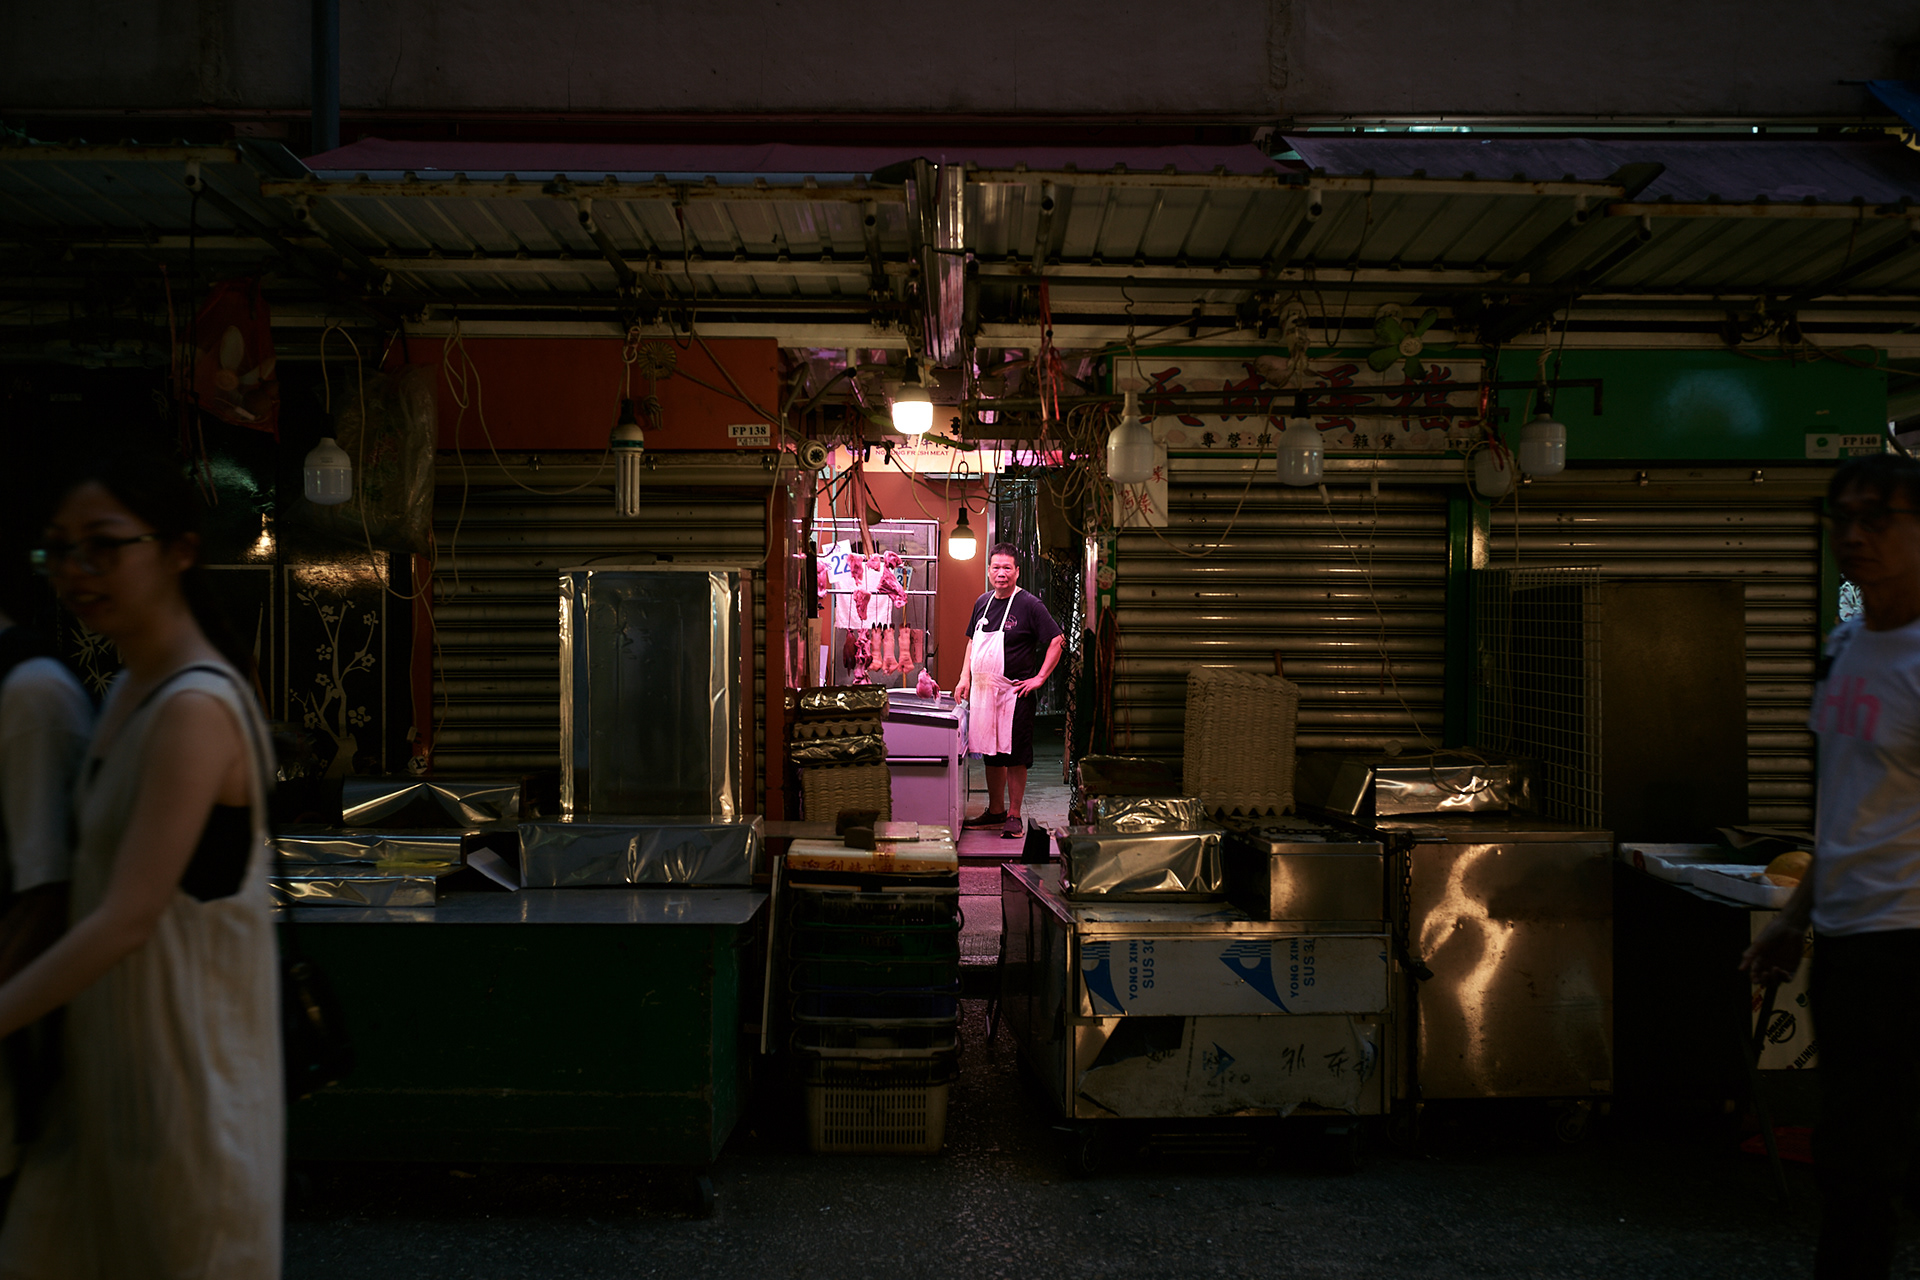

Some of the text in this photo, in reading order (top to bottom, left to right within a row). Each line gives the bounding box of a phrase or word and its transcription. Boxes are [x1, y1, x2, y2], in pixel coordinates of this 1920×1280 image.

[732, 426, 767, 436] FP 138
[1843, 436, 1878, 446] FP 140
[1129, 966, 1138, 1000] YONG
[1142, 958, 1154, 989] SUS
[1290, 965, 1299, 998] YONG
[1303, 956, 1315, 986] SUS
